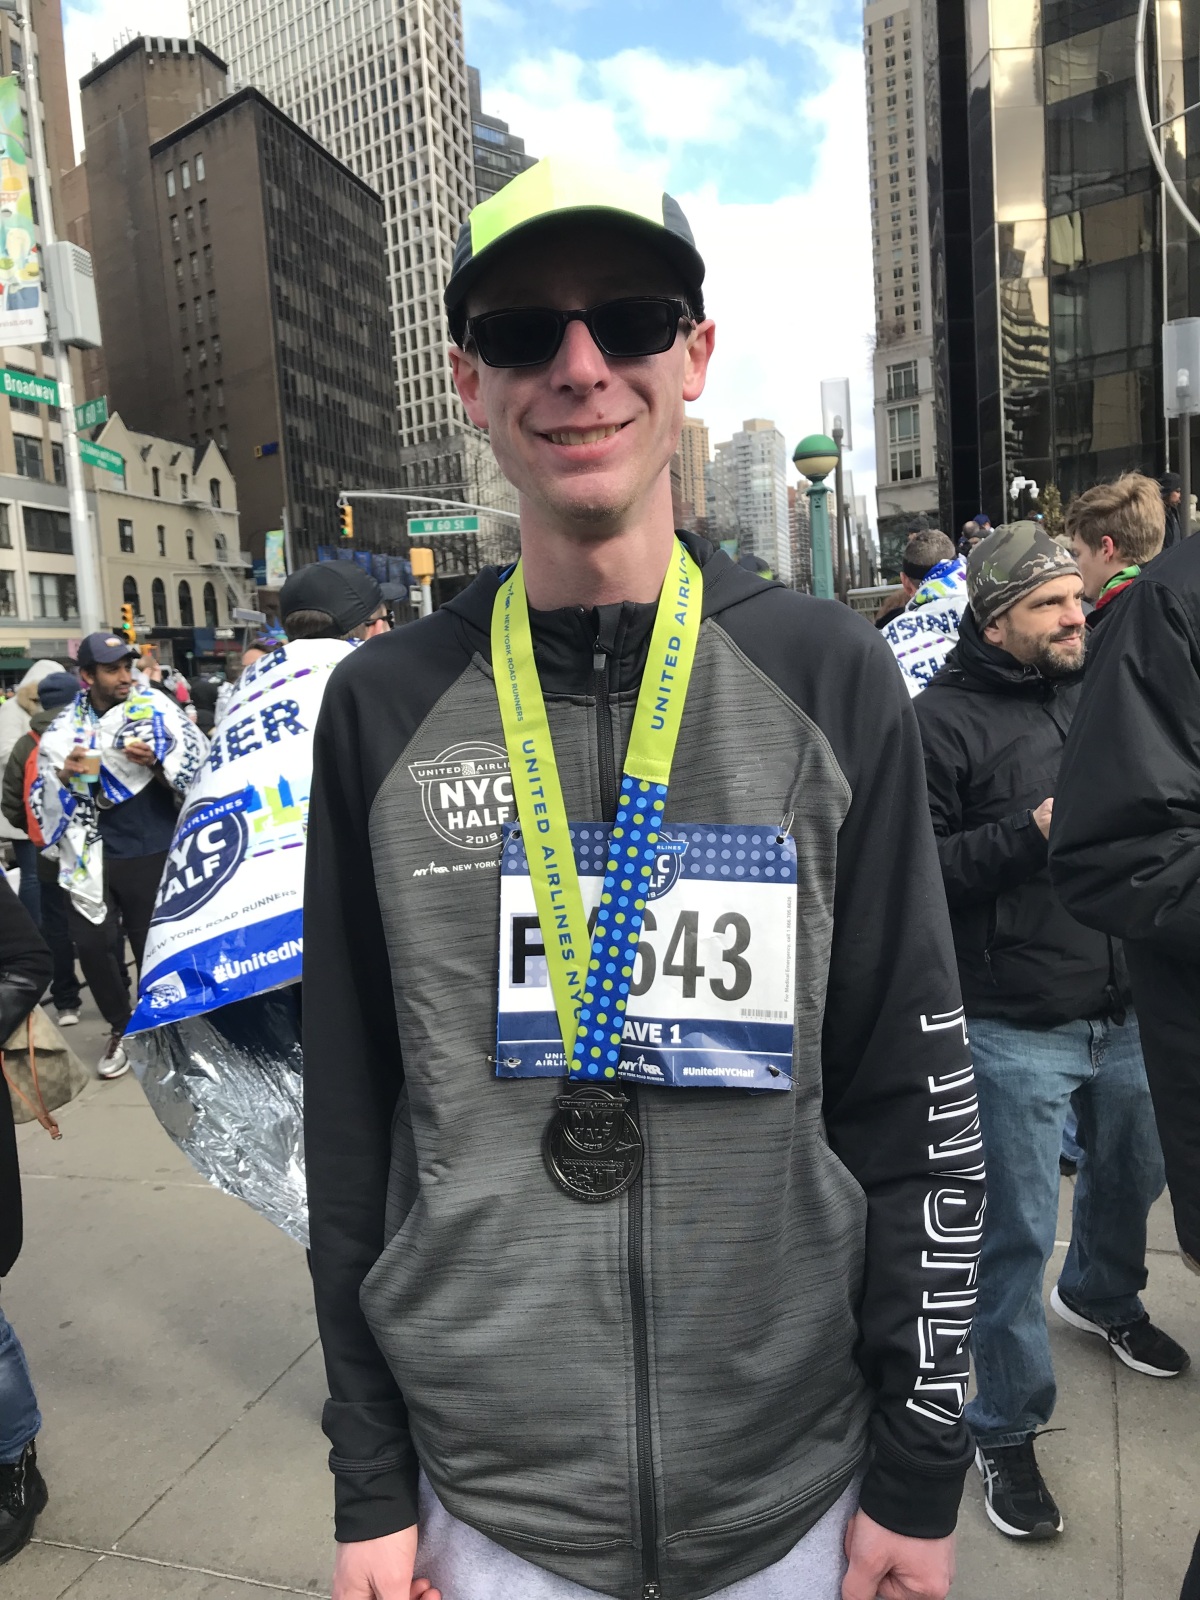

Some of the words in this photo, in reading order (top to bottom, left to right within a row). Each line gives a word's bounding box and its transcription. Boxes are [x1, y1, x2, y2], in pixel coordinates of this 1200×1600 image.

[3, 372, 55, 405] Broadway
[86, 404, 96, 424] 60
[423, 521, 434, 531] W
[437, 520, 451, 530] 60
[454, 519, 465, 529] St
[651, 636, 681, 731] UNITED
[674, 548, 690, 626] AIRLIN
[507, 657, 516, 681] ROAD
[511, 683, 524, 722] RUNNERS
[418, 766, 461, 777] UNITED
[476, 762, 511, 771] AIRLI
[440, 776, 514, 809] NYC
[179, 798, 243, 836] AIRLINES
[447, 806, 510, 830] HALF
[169, 821, 227, 871] YC
[465, 832, 498, 844] 2019
[521, 739, 550, 834] UNITED
[541, 845, 575, 961] AIRLINES
[452, 863, 472, 872] NEW
[474, 860, 497, 869] YORK
[649, 875, 666, 888] LF
[145, 939, 167, 960] NEW
[169, 926, 202, 942] YORK
[205, 911, 239, 929] ROAD
[242, 889, 297, 914] RUNNERS
[587, 906, 752, 1001] 643
[621, 1020, 662, 1043] AVE
[670, 1024, 682, 1044] 1
[683, 1066, 755, 1078] #UnitedNYCHalf
